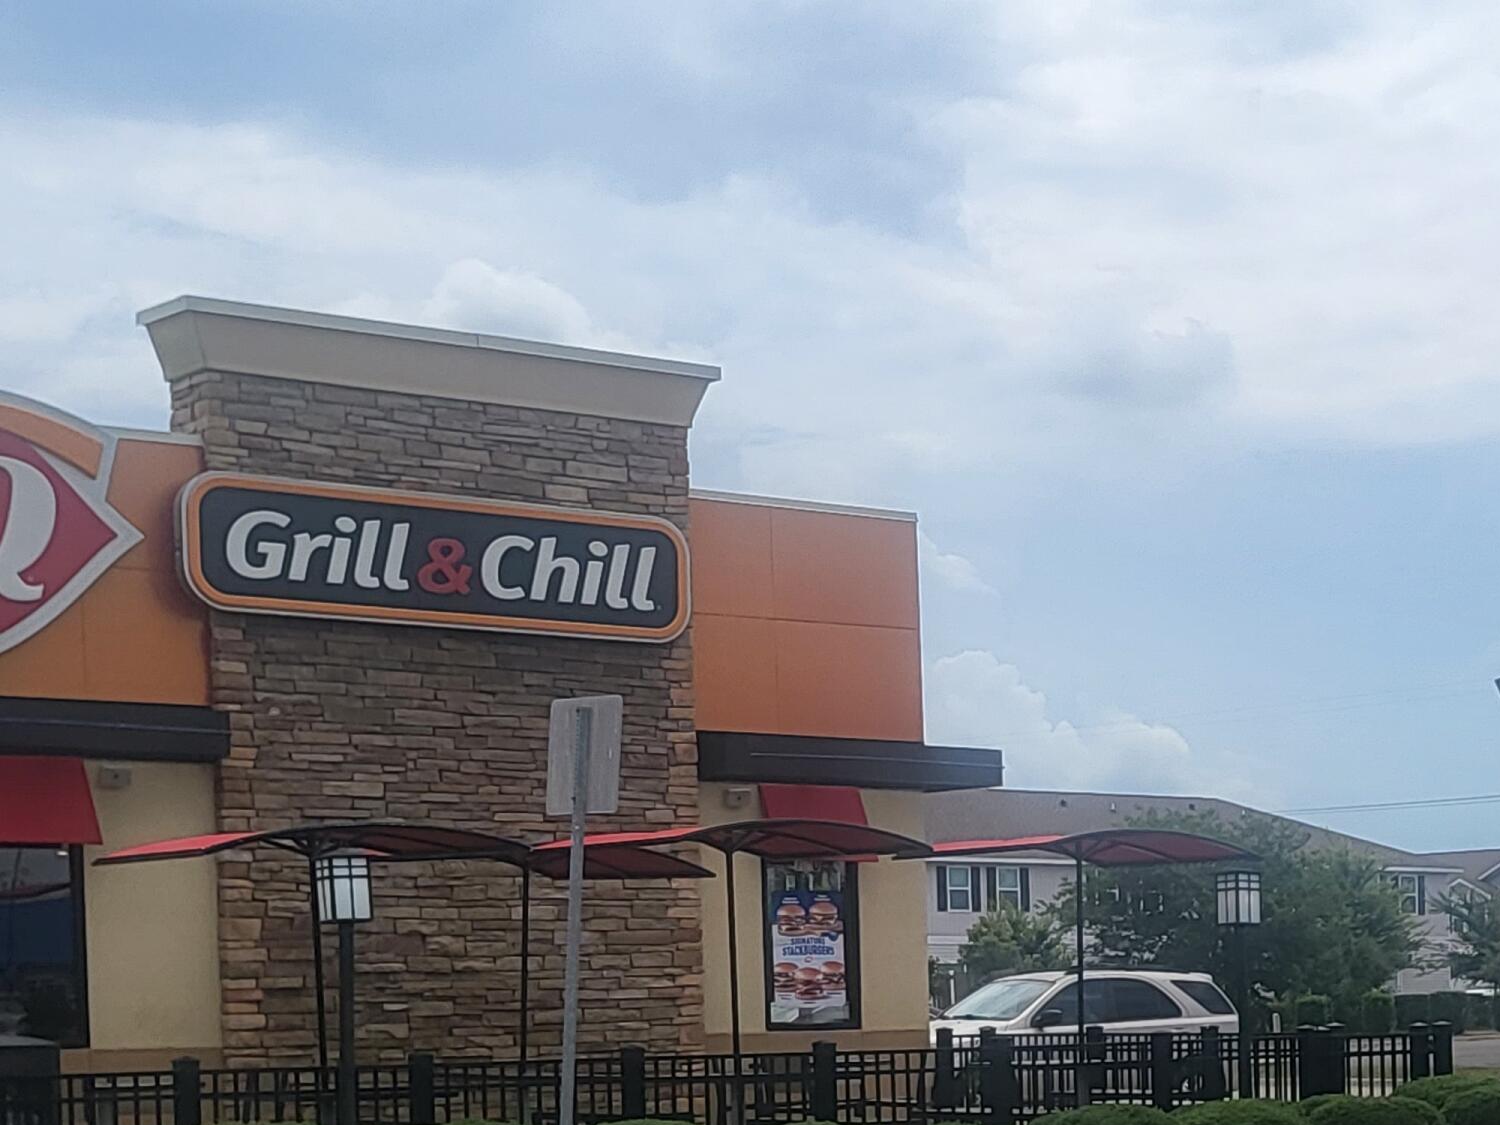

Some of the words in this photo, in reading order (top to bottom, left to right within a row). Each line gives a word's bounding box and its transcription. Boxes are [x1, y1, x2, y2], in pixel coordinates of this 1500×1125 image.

[225, 510, 410, 591] Grill
[417, 537, 473, 595] &
[480, 534, 657, 611] Chill
